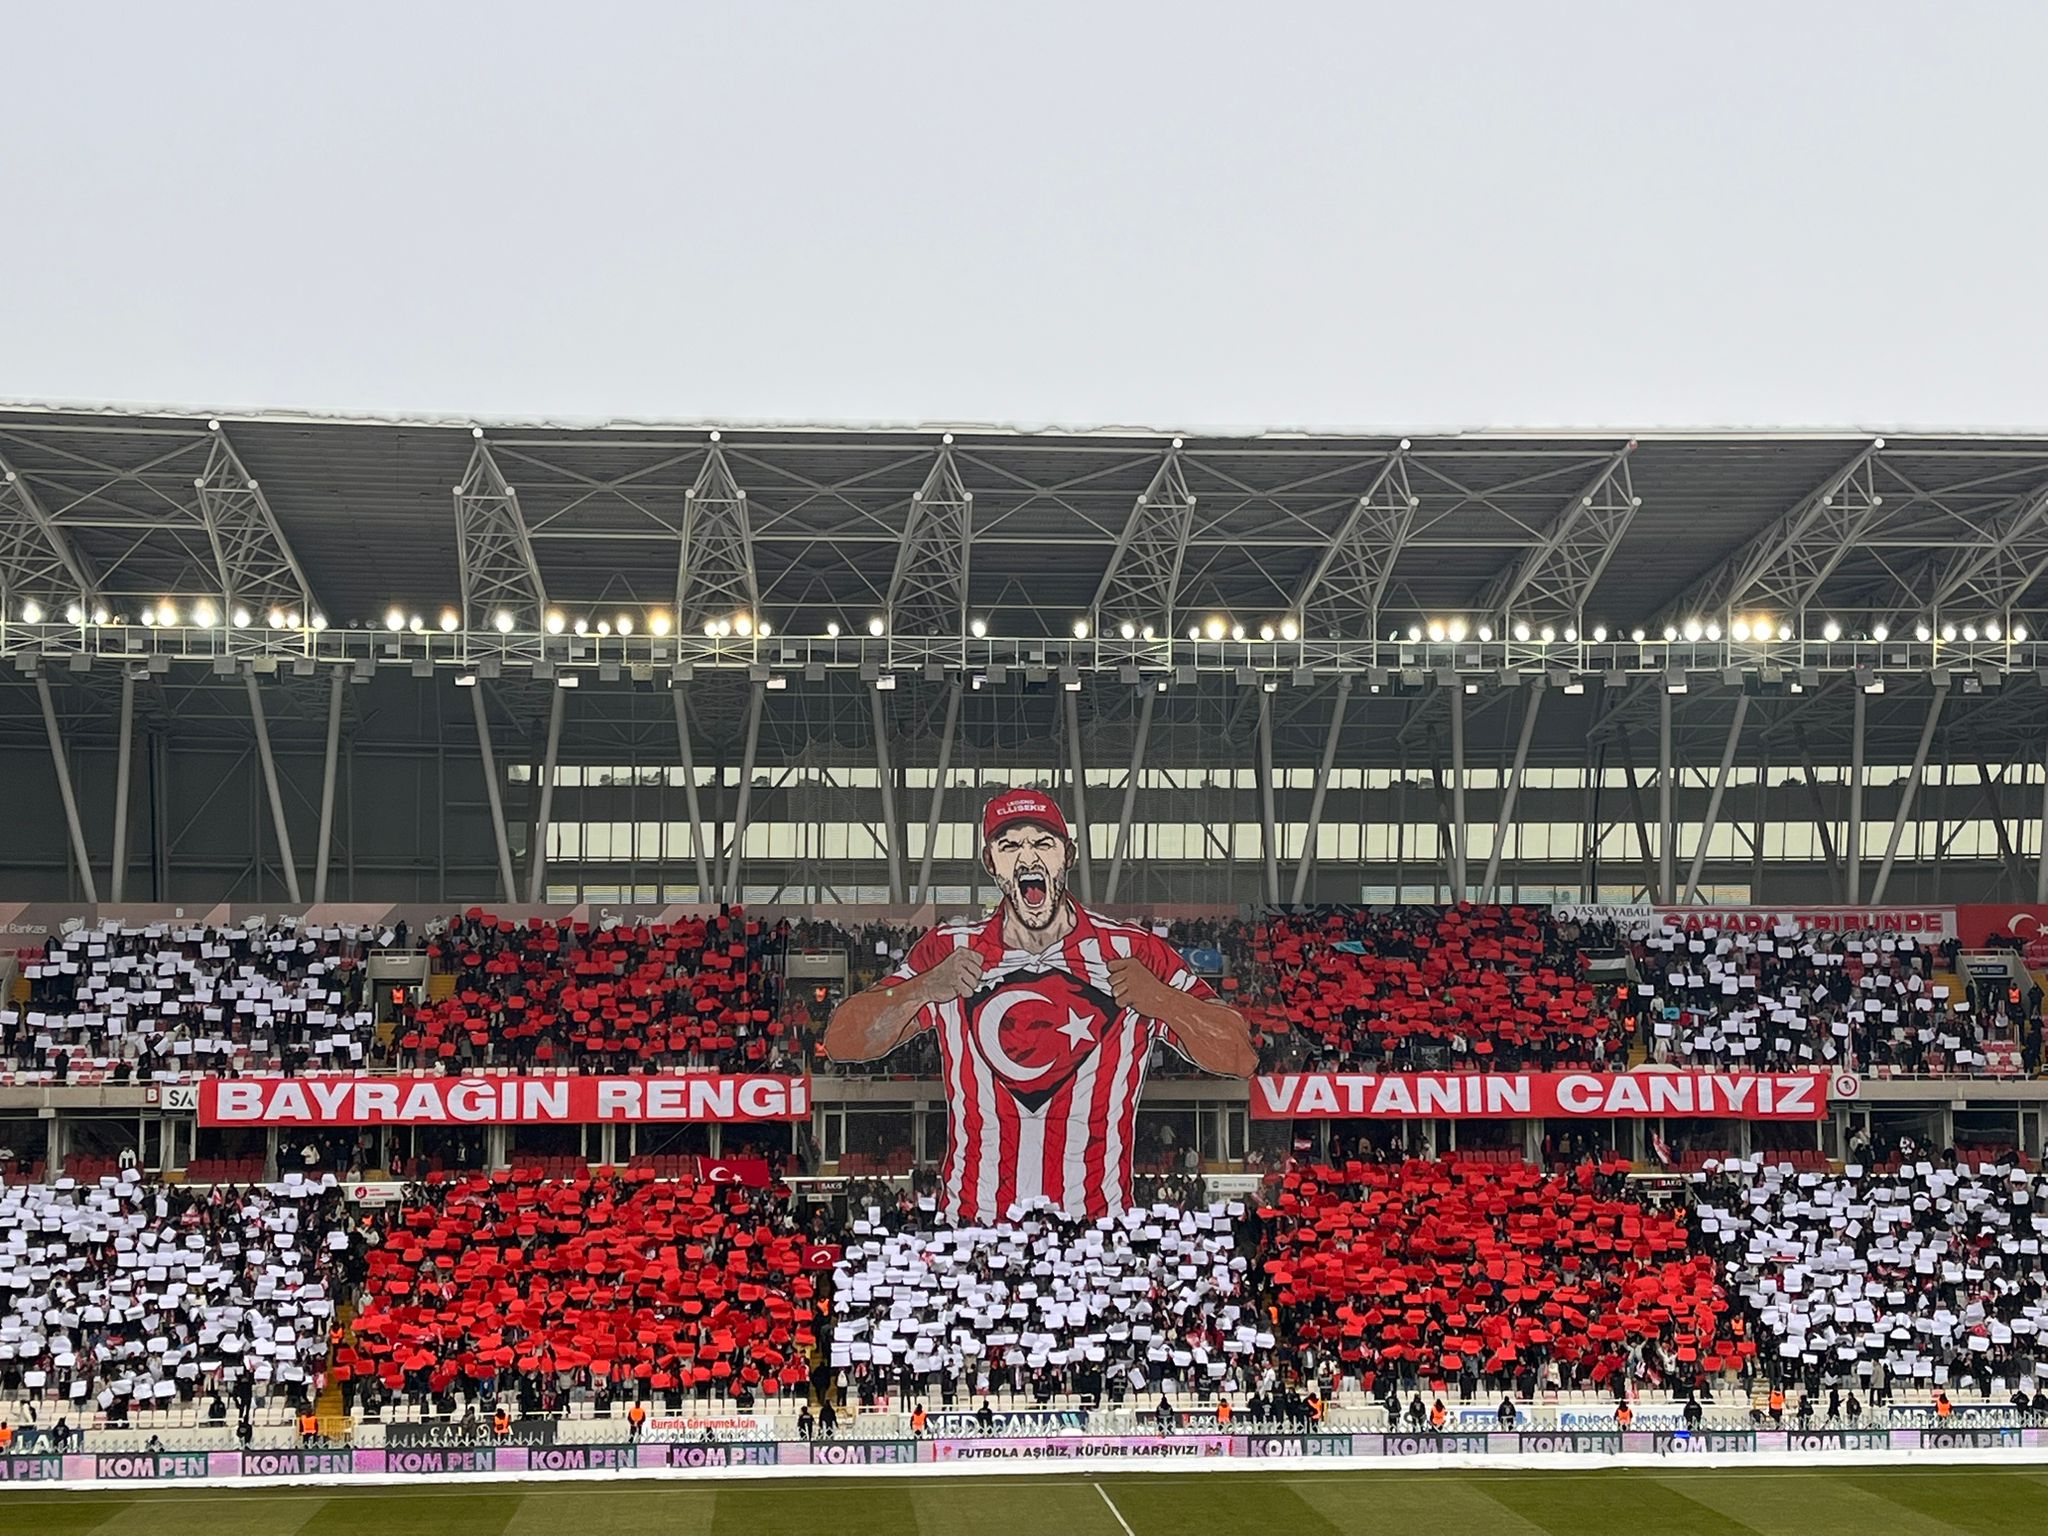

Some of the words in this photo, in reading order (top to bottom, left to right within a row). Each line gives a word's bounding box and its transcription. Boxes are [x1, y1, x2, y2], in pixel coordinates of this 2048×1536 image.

[9, 922, 48, 934] Bankası
[1662, 913, 1782, 932] SAHADA
[217, 1079, 569, 1121] BAYRAĞIN
[1257, 1076, 1531, 1113] VATANIN
[1556, 1075, 1815, 1113] CANIYIZ
[927, 1414, 1058, 1439] MEDCANA
[957, 1448, 1019, 1459] FUTBOLA
[1075, 1443, 1128, 1457] KÜFÜRE
[1132, 1444, 1199, 1457] KARŞIYIZ!
[13, 1459, 60, 1479] PEN
